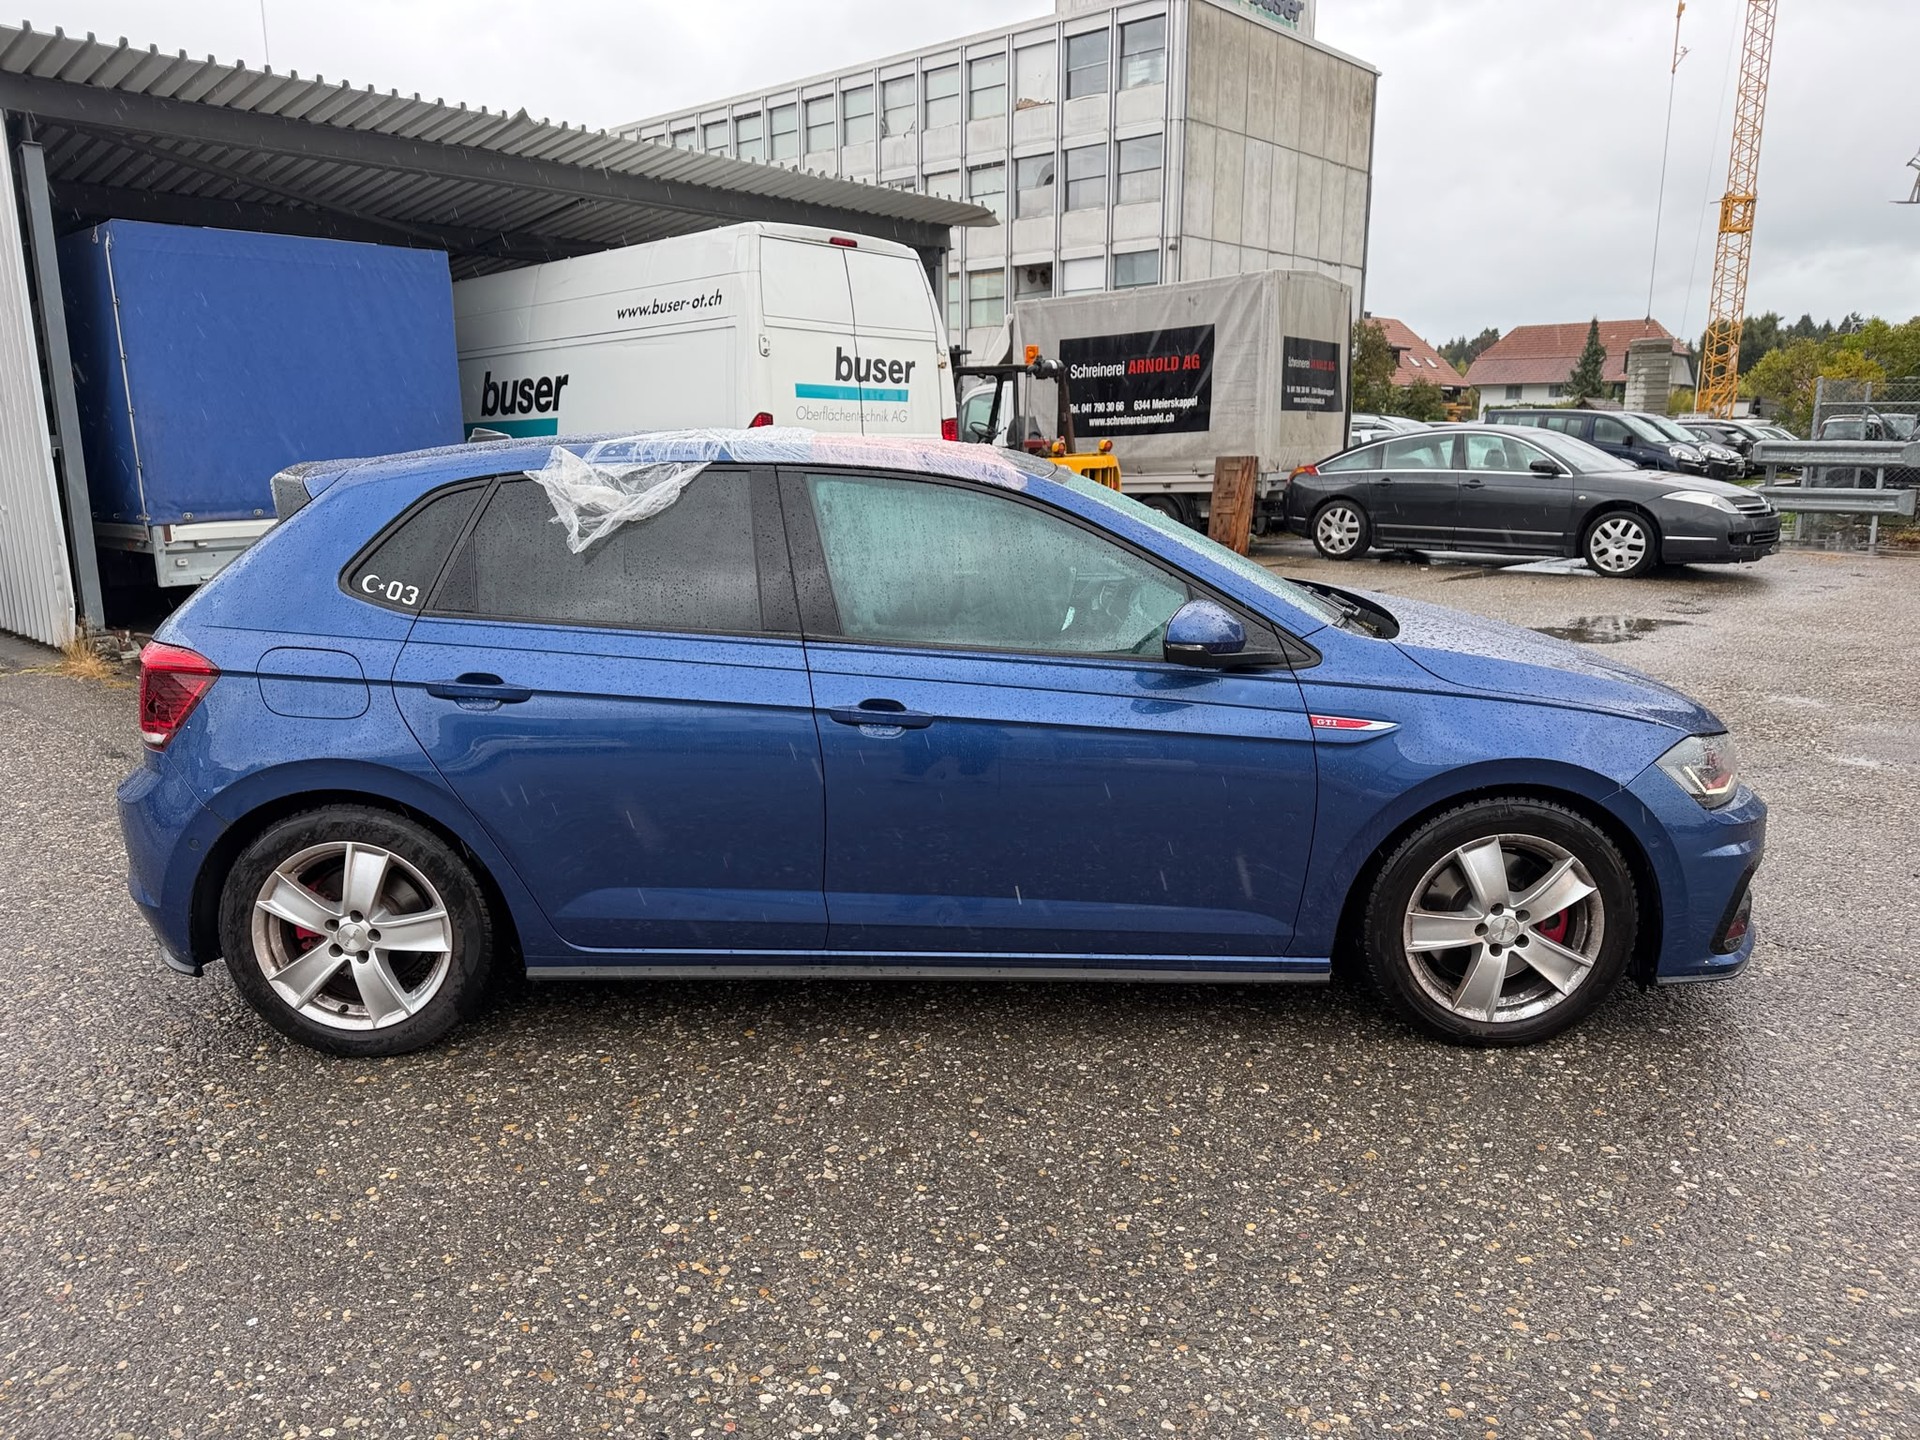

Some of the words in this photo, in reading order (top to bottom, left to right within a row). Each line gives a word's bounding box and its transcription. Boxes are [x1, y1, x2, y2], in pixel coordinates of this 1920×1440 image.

[1249, 0, 1304, 23] user
[617, 288, 723, 320] www.buser-ot.ch
[835, 346, 916, 384] buser
[1070, 360, 1125, 379] Schreinerei
[1128, 354, 1180, 375] ARNOLD
[1182, 353, 1201, 370] AG
[480, 370, 569, 417] buser
[1069, 403, 1080, 414] Tel.
[1081, 402, 1092, 413] 041
[1093, 402, 1105, 413] 790
[1106, 401, 1115, 413] 30
[1134, 399, 1150, 411] 6344
[1151, 396, 1198, 410] Meierskappel
[796, 405, 889, 422] Oberflächentechnik
[891, 409, 908, 423] AG
[1089, 412, 1175, 427] www.schreinereiarnold.ch
[1317, 718, 1338, 726] GTI
